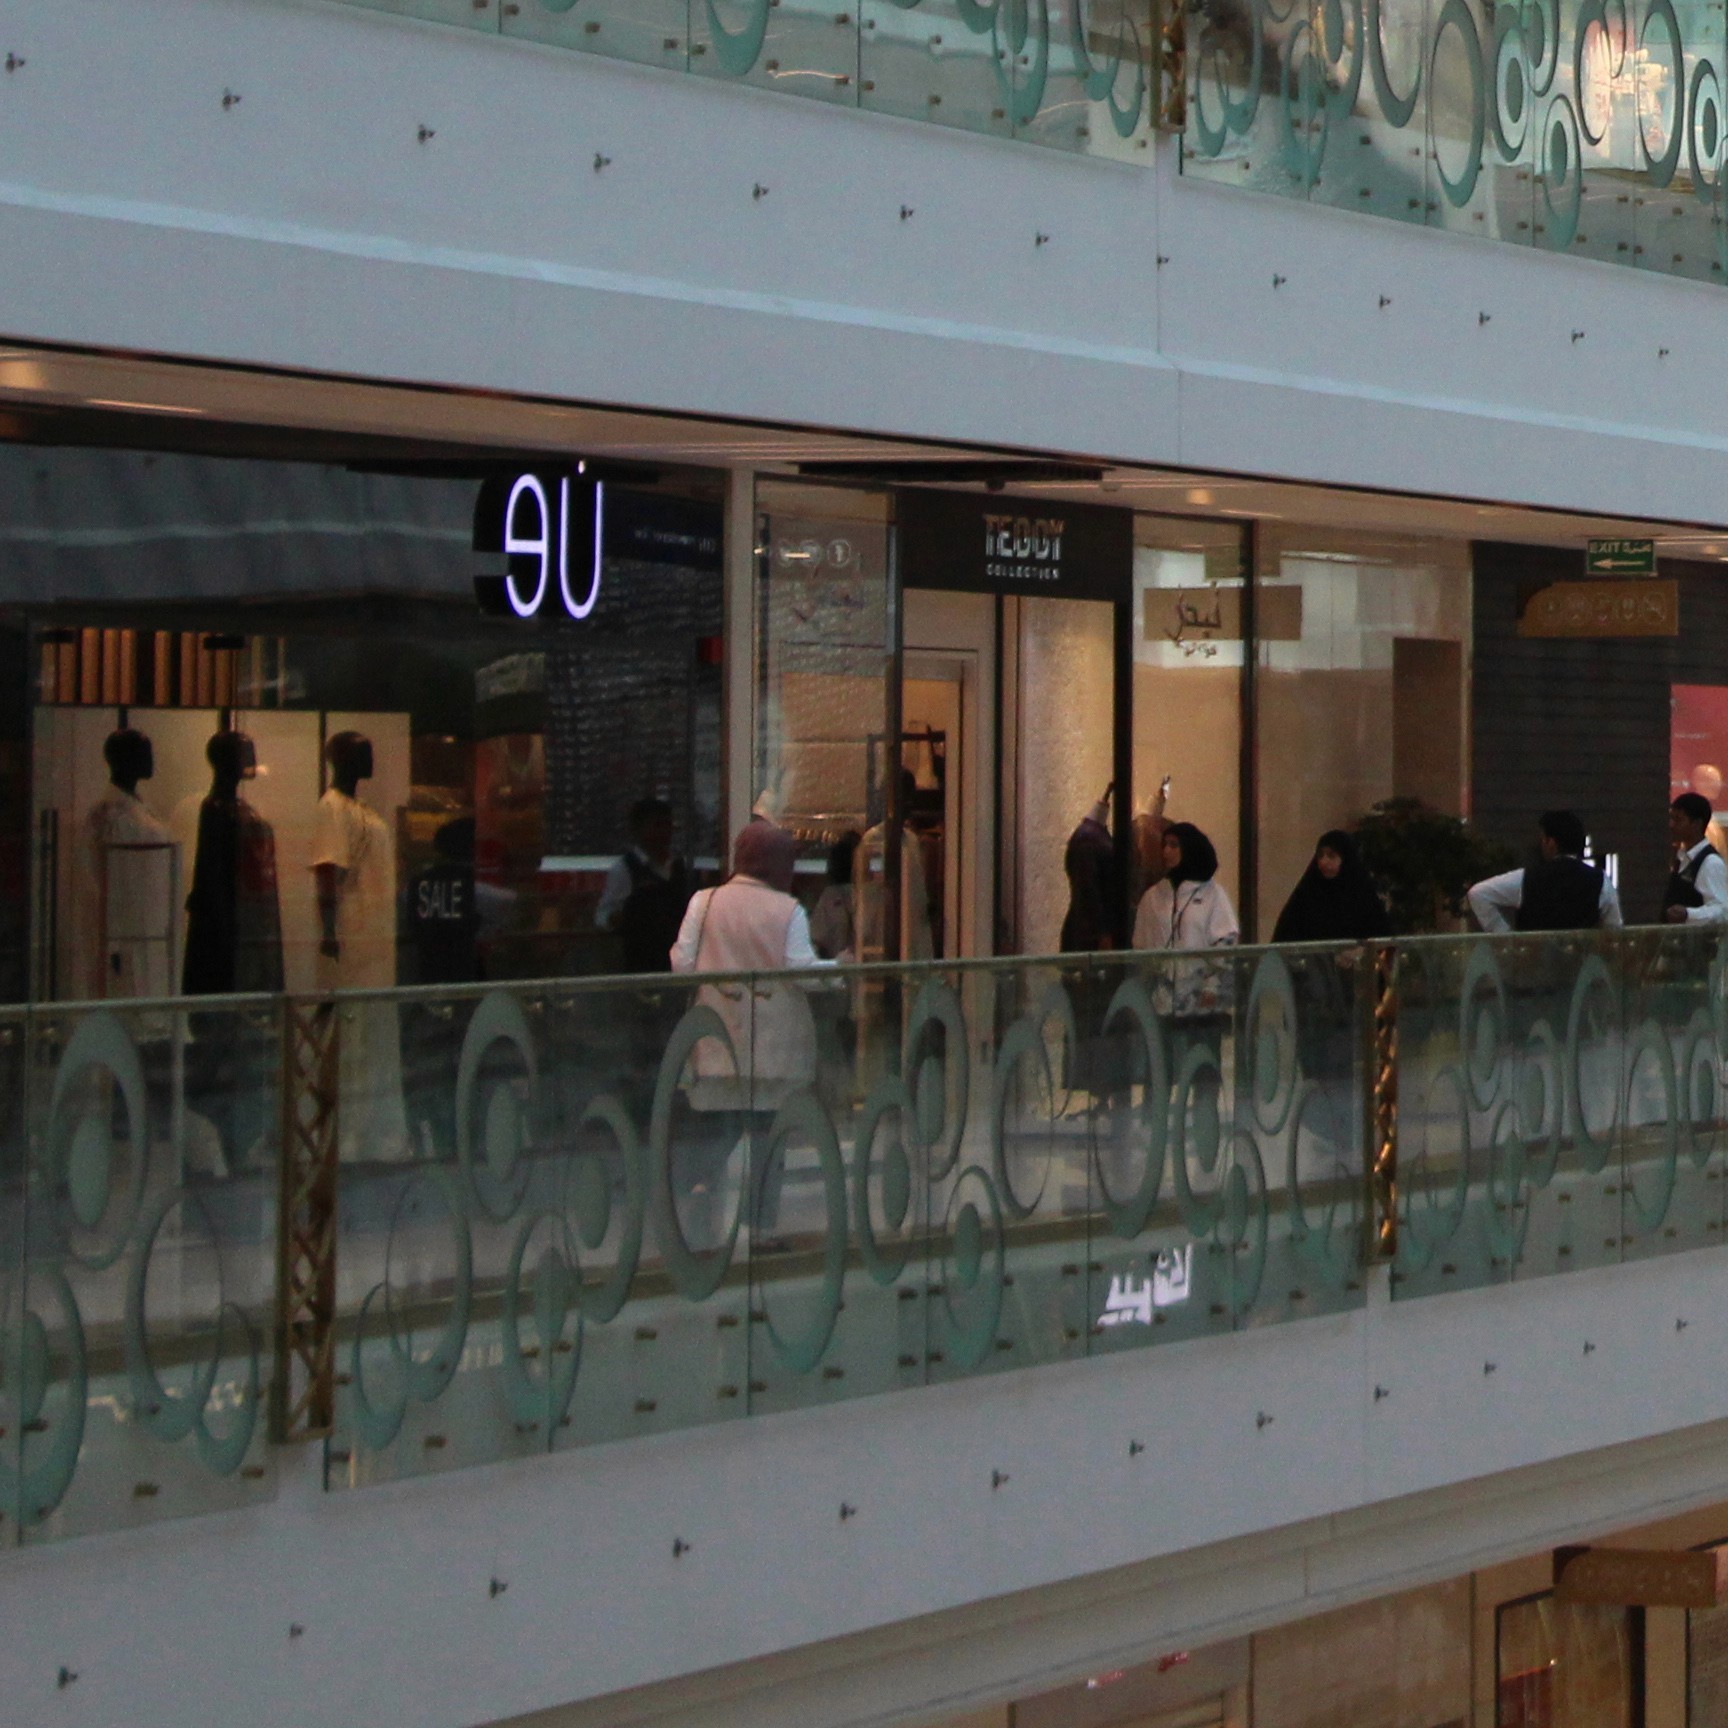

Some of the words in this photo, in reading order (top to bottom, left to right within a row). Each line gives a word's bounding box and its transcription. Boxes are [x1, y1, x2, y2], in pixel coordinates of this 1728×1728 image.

[982, 514, 1064, 561] TEDDY
[1589, 541, 1620, 554] EXIT
[417, 880, 462, 919] SALE
